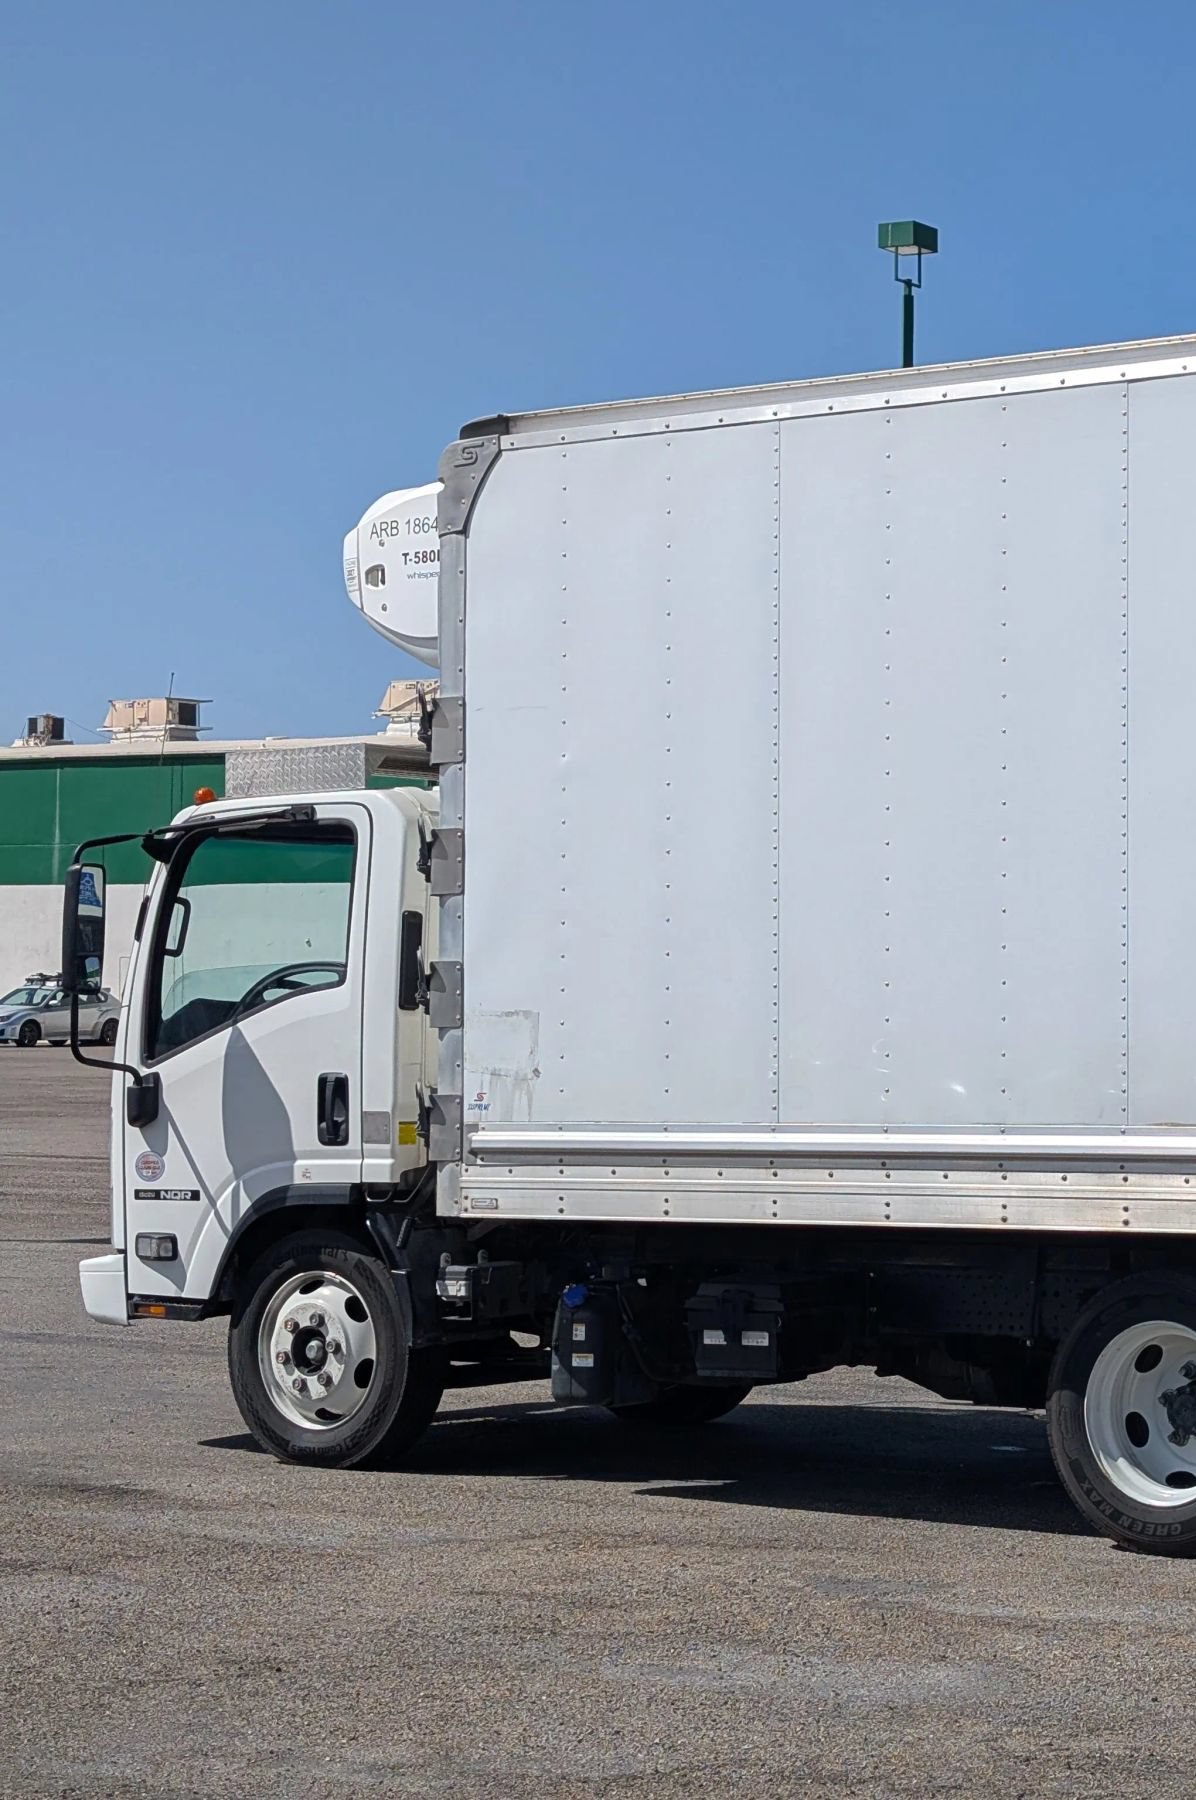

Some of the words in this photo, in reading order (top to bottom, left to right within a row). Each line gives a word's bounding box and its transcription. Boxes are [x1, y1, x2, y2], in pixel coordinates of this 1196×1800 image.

[370, 520, 400, 540] ARB
[405, 516, 438, 535] 1864
[160, 1190, 192, 1200] NQR
[1080, 1479, 1115, 1516] MAX
[1117, 1515, 1182, 1536] GREEN
